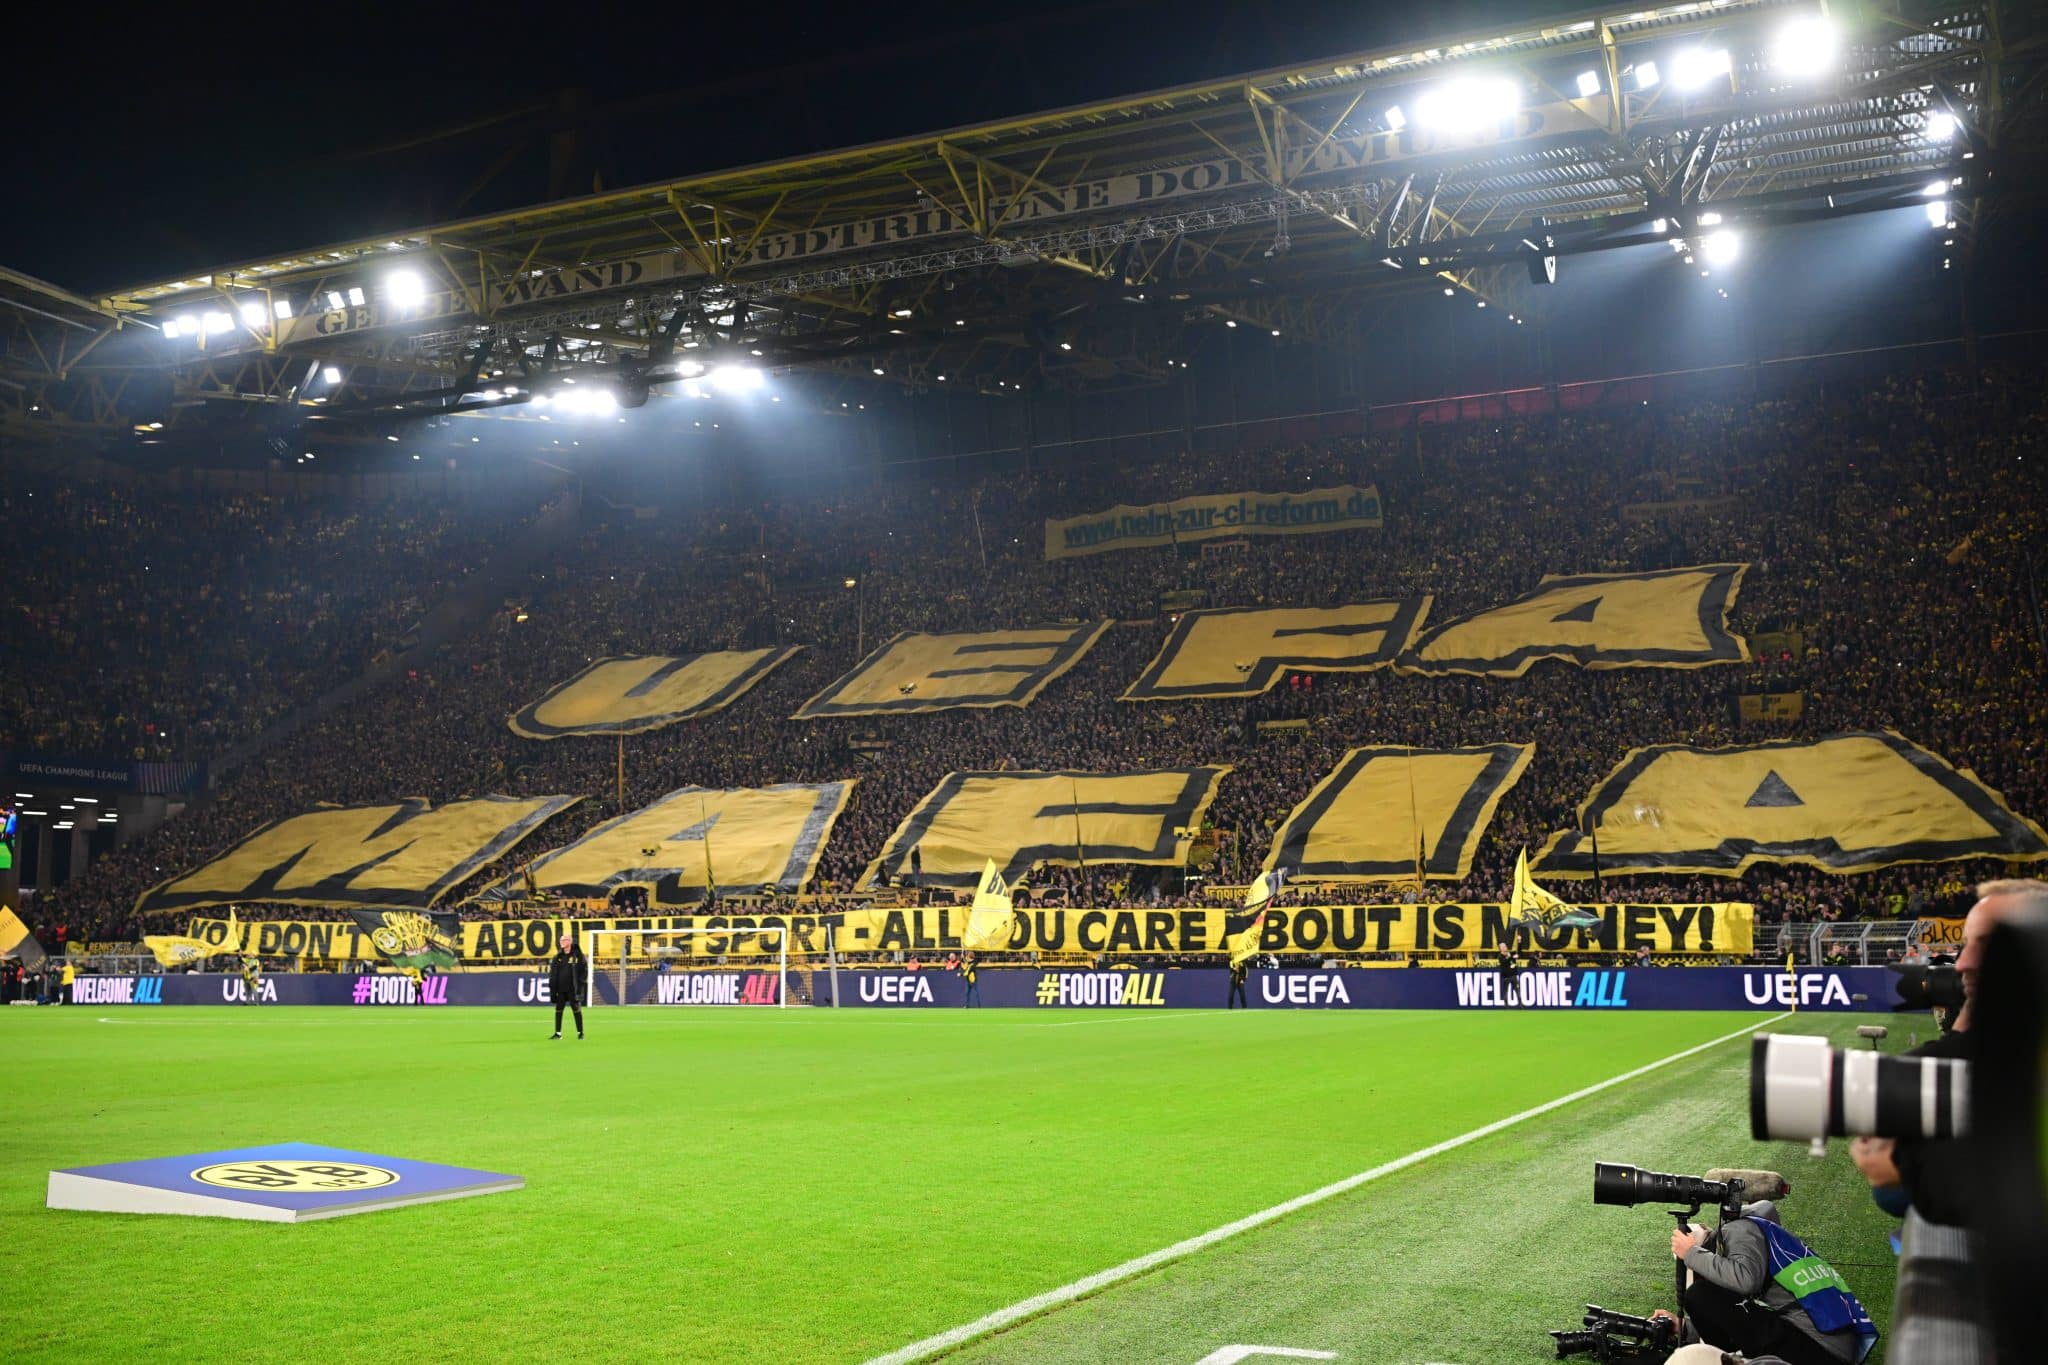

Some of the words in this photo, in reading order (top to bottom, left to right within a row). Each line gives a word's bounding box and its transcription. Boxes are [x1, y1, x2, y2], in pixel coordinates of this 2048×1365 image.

[316, 290, 467, 335] GELE
[496, 261, 643, 302] WAND
[727, 182, 1110, 266] SÜDTRIBÜNE
[1136, 111, 1545, 200] DORTMUD
[20, 764, 42, 774] UEFA
[45, 767, 95, 779] CHAMPIONS
[97, 771, 128, 782] LEAGUE
[474, 919, 606, 957] ABOUT
[705, 914, 844, 954] SPORT
[878, 908, 961, 950] ALL
[1007, 909, 1064, 950] OU
[1077, 909, 1206, 952] CARE
[1218, 907, 1401, 951] BOUT
[1416, 904, 1465, 950] IS
[72, 977, 133, 1004] WELCOME
[134, 977, 163, 1004] ALL
[657, 975, 740, 1004] WELCOME
[740, 974, 778, 1004] ALL
[860, 976, 934, 1002] UEFA
[1036, 973, 1166, 1006] #FOOTBALL
[1262, 975, 1350, 1004] UEFA
[1574, 971, 1628, 1007] ALL
[1744, 973, 1851, 1005] UEFA
[220, 1164, 368, 1188] BVB
